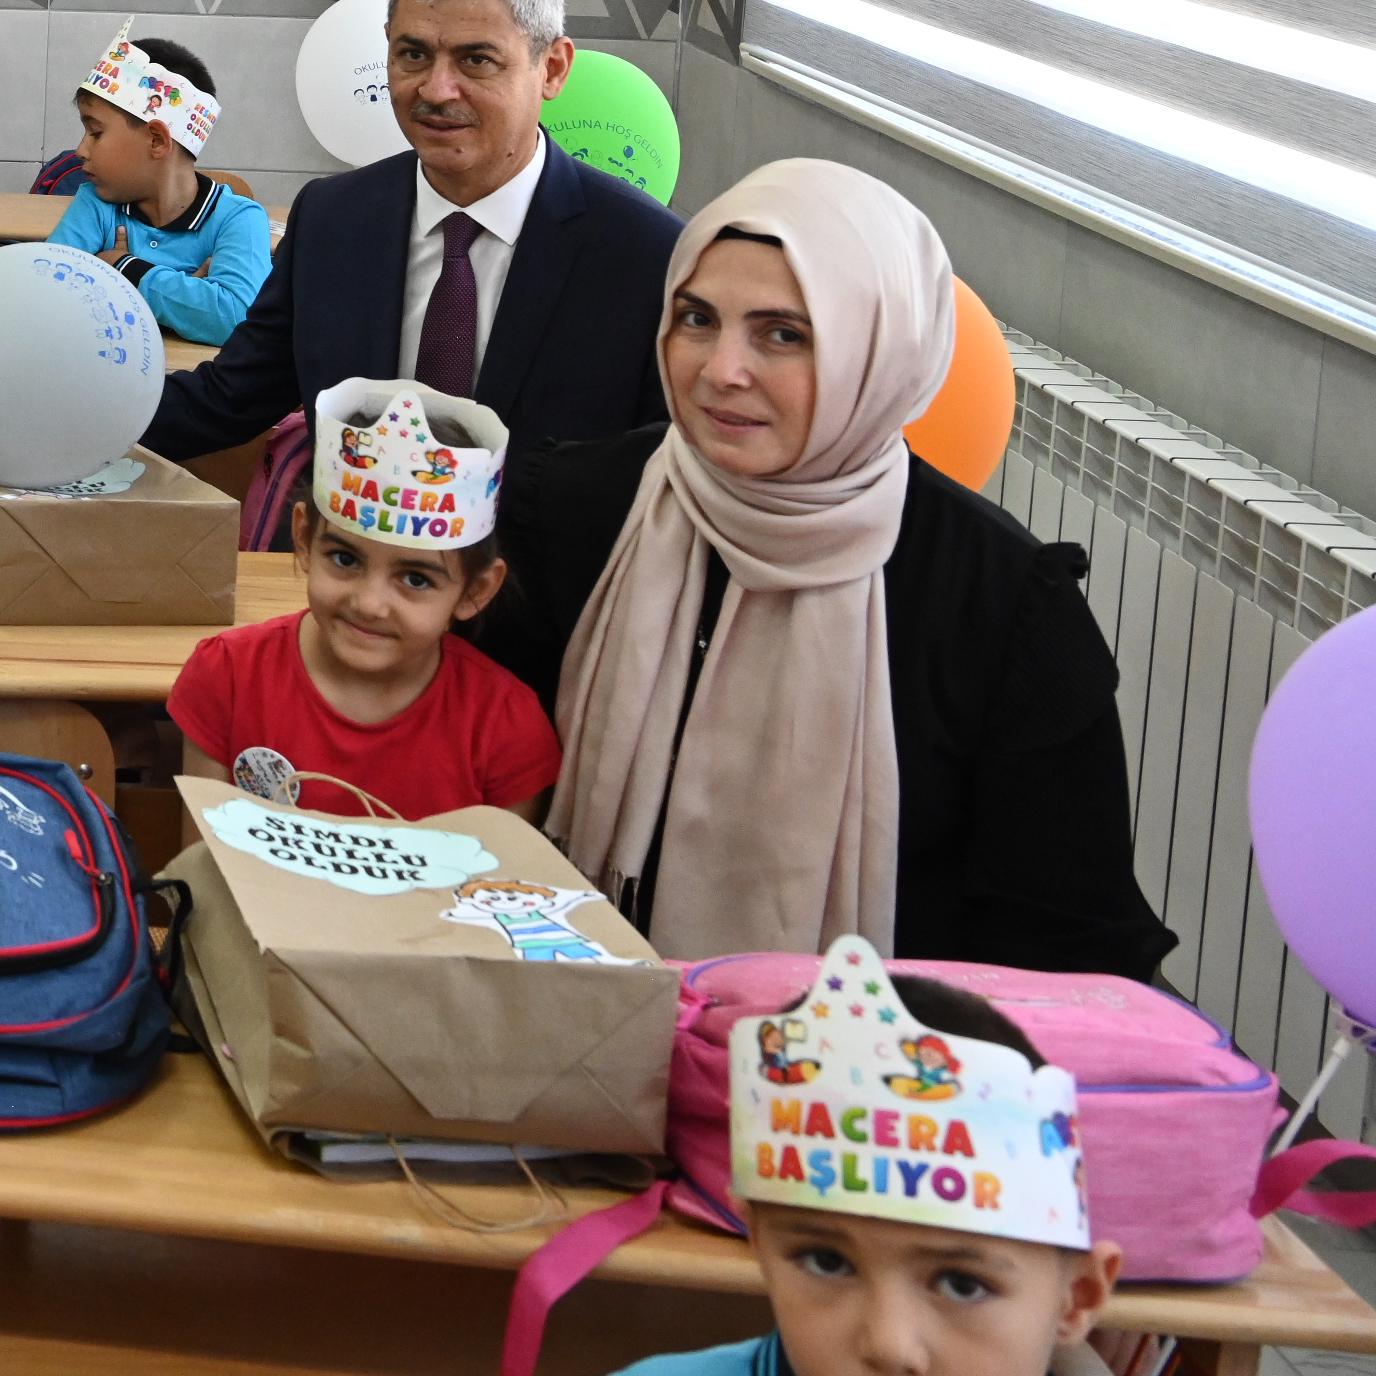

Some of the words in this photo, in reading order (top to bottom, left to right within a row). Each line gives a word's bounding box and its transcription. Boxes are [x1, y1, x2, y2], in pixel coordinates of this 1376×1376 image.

[546, 119, 602, 133] KULUNA
[606, 122, 633, 140] HOŞ
[341, 471, 456, 513] MACERA
[329, 490, 465, 538] BAŞLIYOR
[247, 828, 428, 867] OKULLU
[269, 847, 426, 882] OLDUK
[770, 1098, 975, 1159] MACERA
[756, 1141, 1003, 1210] BAŞLIYOR
